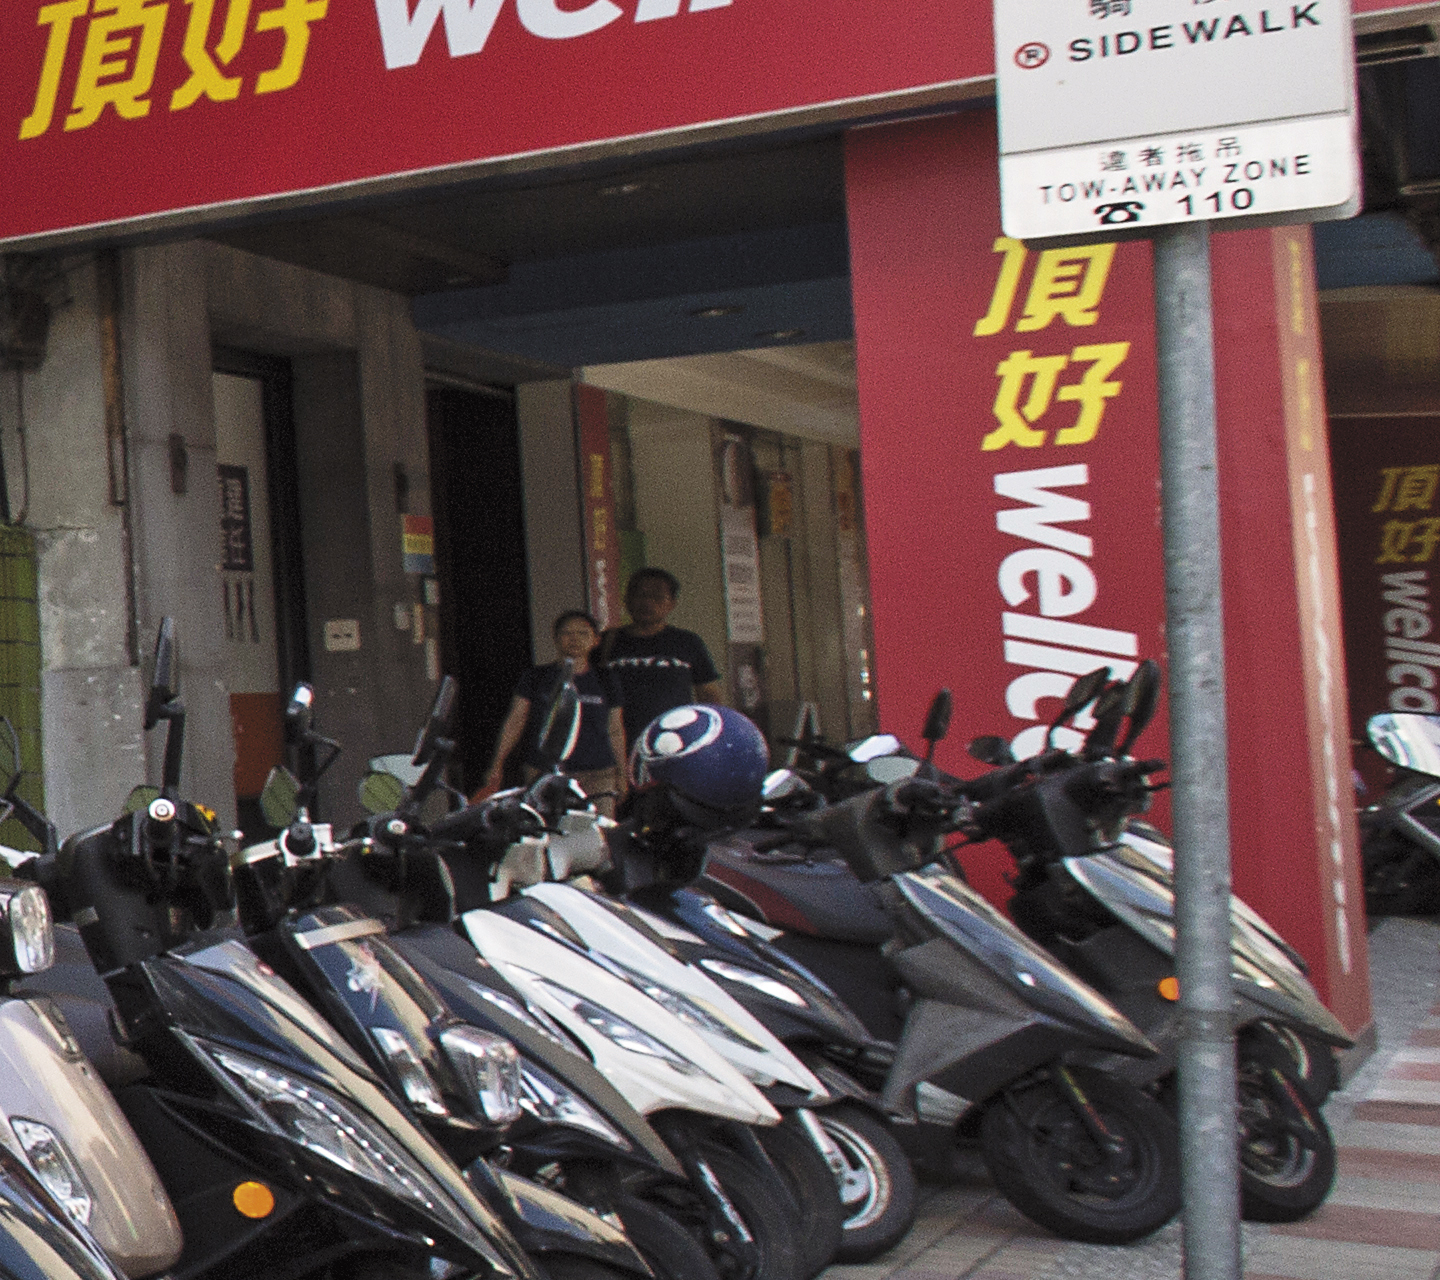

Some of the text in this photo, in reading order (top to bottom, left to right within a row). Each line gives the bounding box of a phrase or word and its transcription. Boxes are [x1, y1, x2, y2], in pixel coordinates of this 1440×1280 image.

[1068, 1, 1321, 63] SIDEWALK
[1039, 155, 1312, 205] TOW-AWAY ZONE
[1099, 137, 1243, 173] 違者拖吊
[1178, 187, 1255, 217] 110
[973, 237, 1130, 452] 頂好
